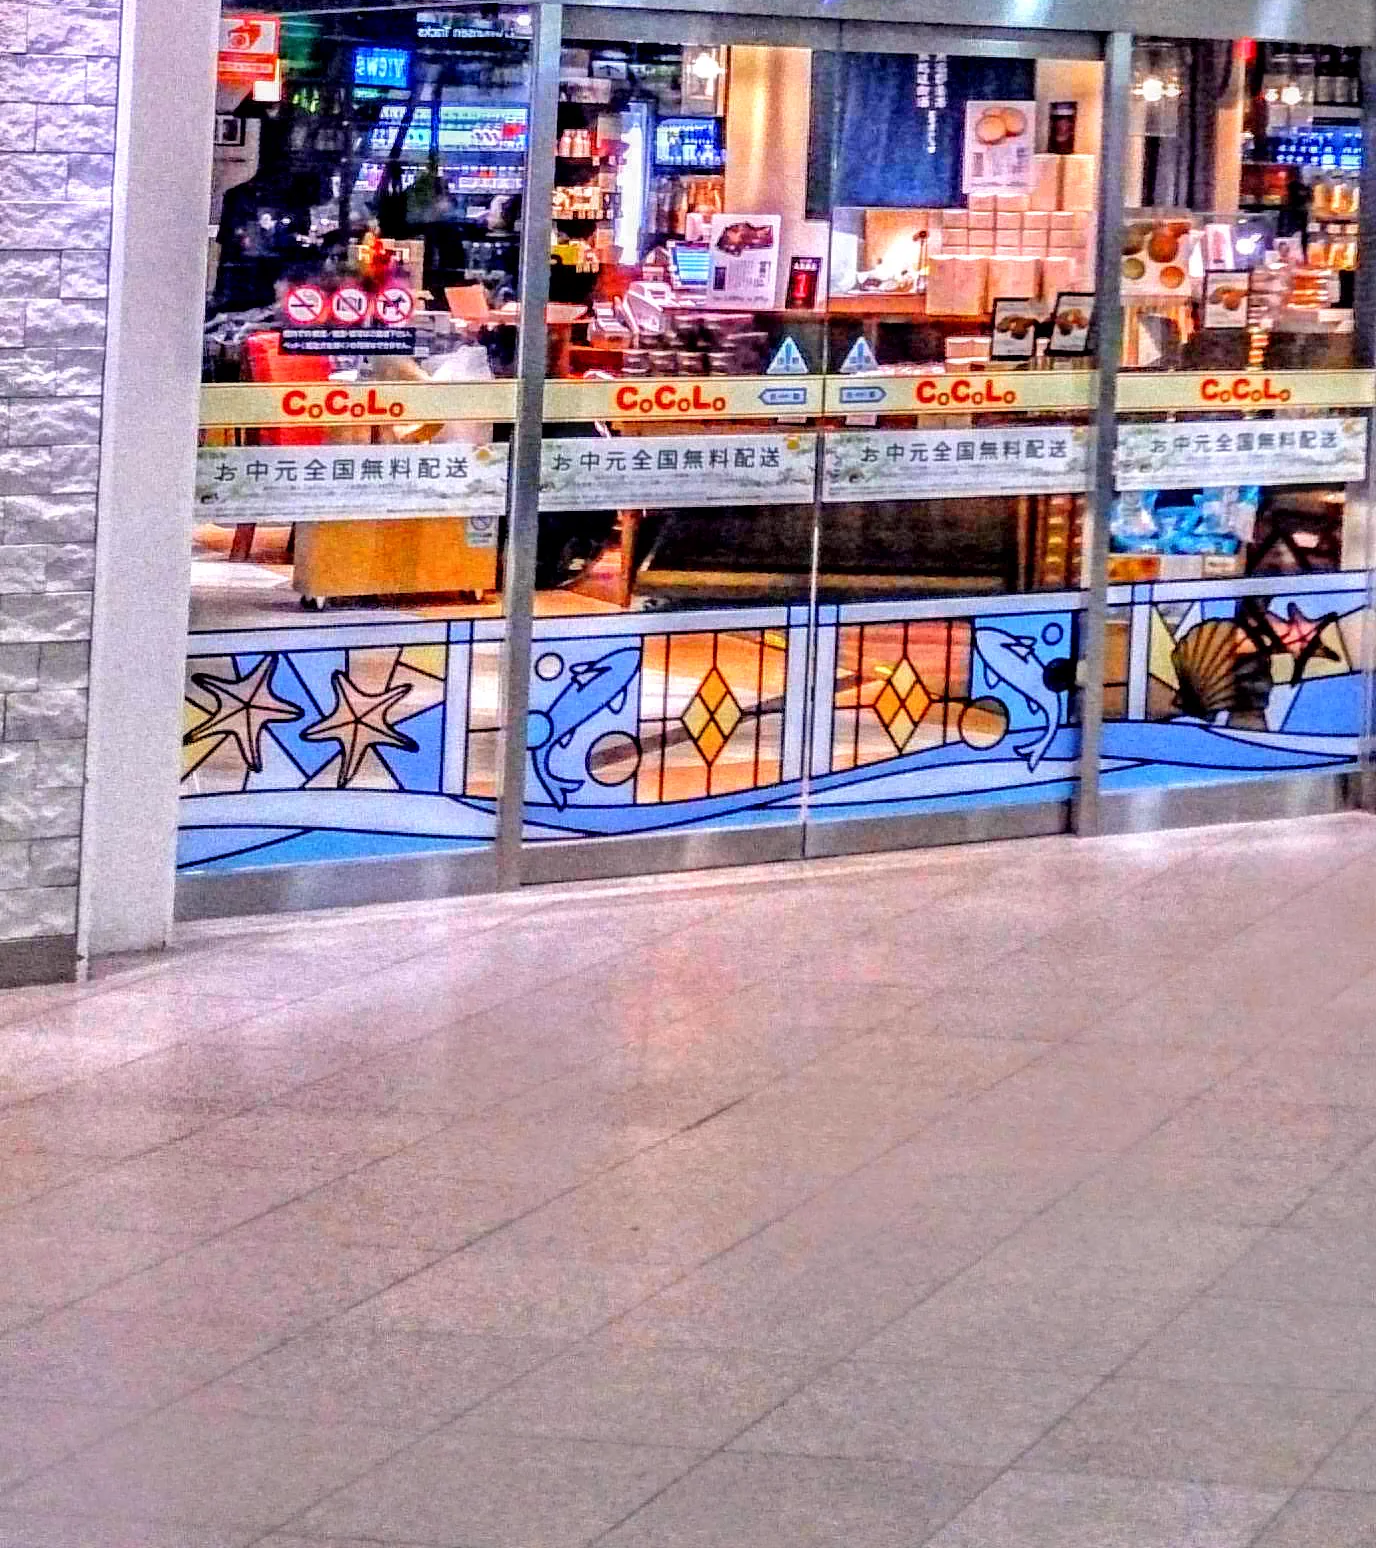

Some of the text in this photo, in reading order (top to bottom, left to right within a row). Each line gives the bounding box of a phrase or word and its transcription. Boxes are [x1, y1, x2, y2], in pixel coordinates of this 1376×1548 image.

[615, 385, 727, 413] CoCoLo
[915, 379, 1017, 405] CoCoLo
[1200, 378, 1291, 403] CoCoLo
[281, 390, 405, 419] CoCoLo
[860, 439, 1068, 462] お中元全国無料配送
[1151, 431, 1338, 453] お中元全国無料配送
[214, 456, 470, 483] お中元全国無料配送
[551, 450, 781, 472] お中元全国無料配送
